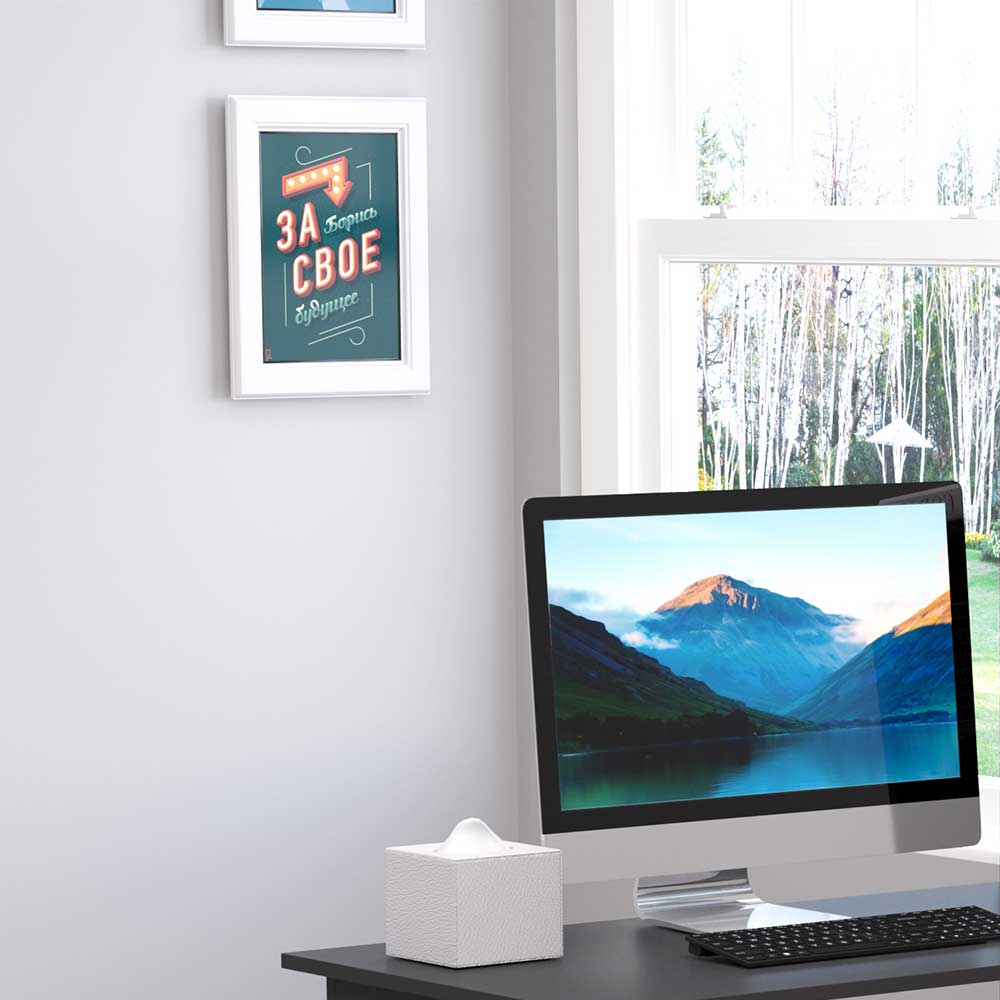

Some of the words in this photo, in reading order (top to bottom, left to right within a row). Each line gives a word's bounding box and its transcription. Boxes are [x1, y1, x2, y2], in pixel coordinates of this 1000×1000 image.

[276, 201, 320, 253] ЗА
[323, 207, 378, 234] Борись
[292, 228, 381, 296] СВОЕ
[295, 292, 360, 327] будущее
